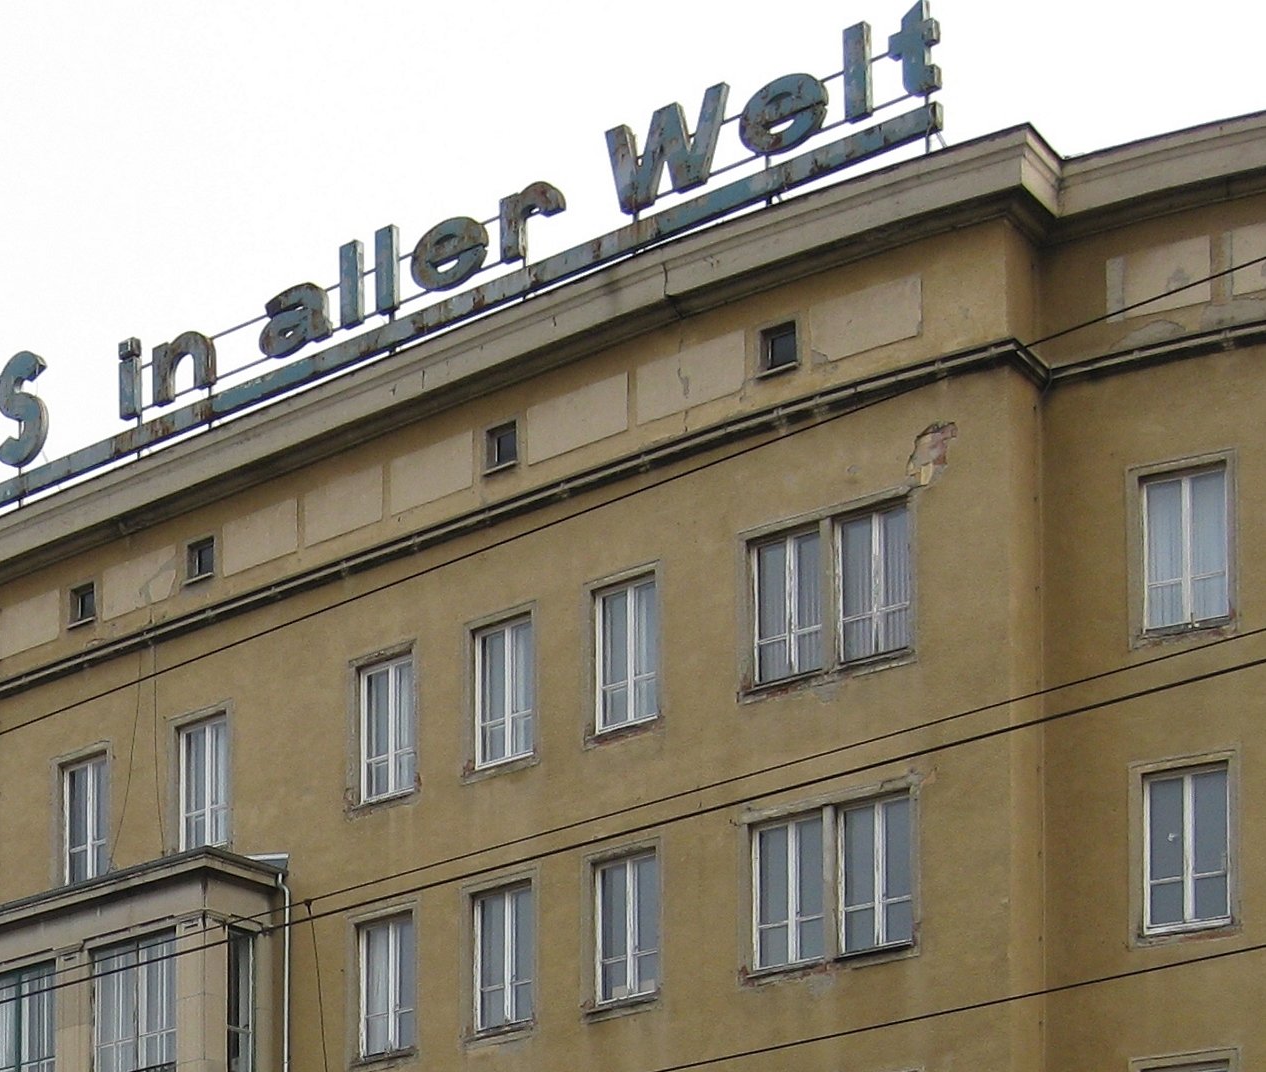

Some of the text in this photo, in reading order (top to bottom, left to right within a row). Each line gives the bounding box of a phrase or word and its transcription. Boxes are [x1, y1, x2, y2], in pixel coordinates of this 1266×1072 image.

[118, 330, 217, 421] in
[259, 181, 566, 359] aller
[605, 0, 942, 214] Welt
